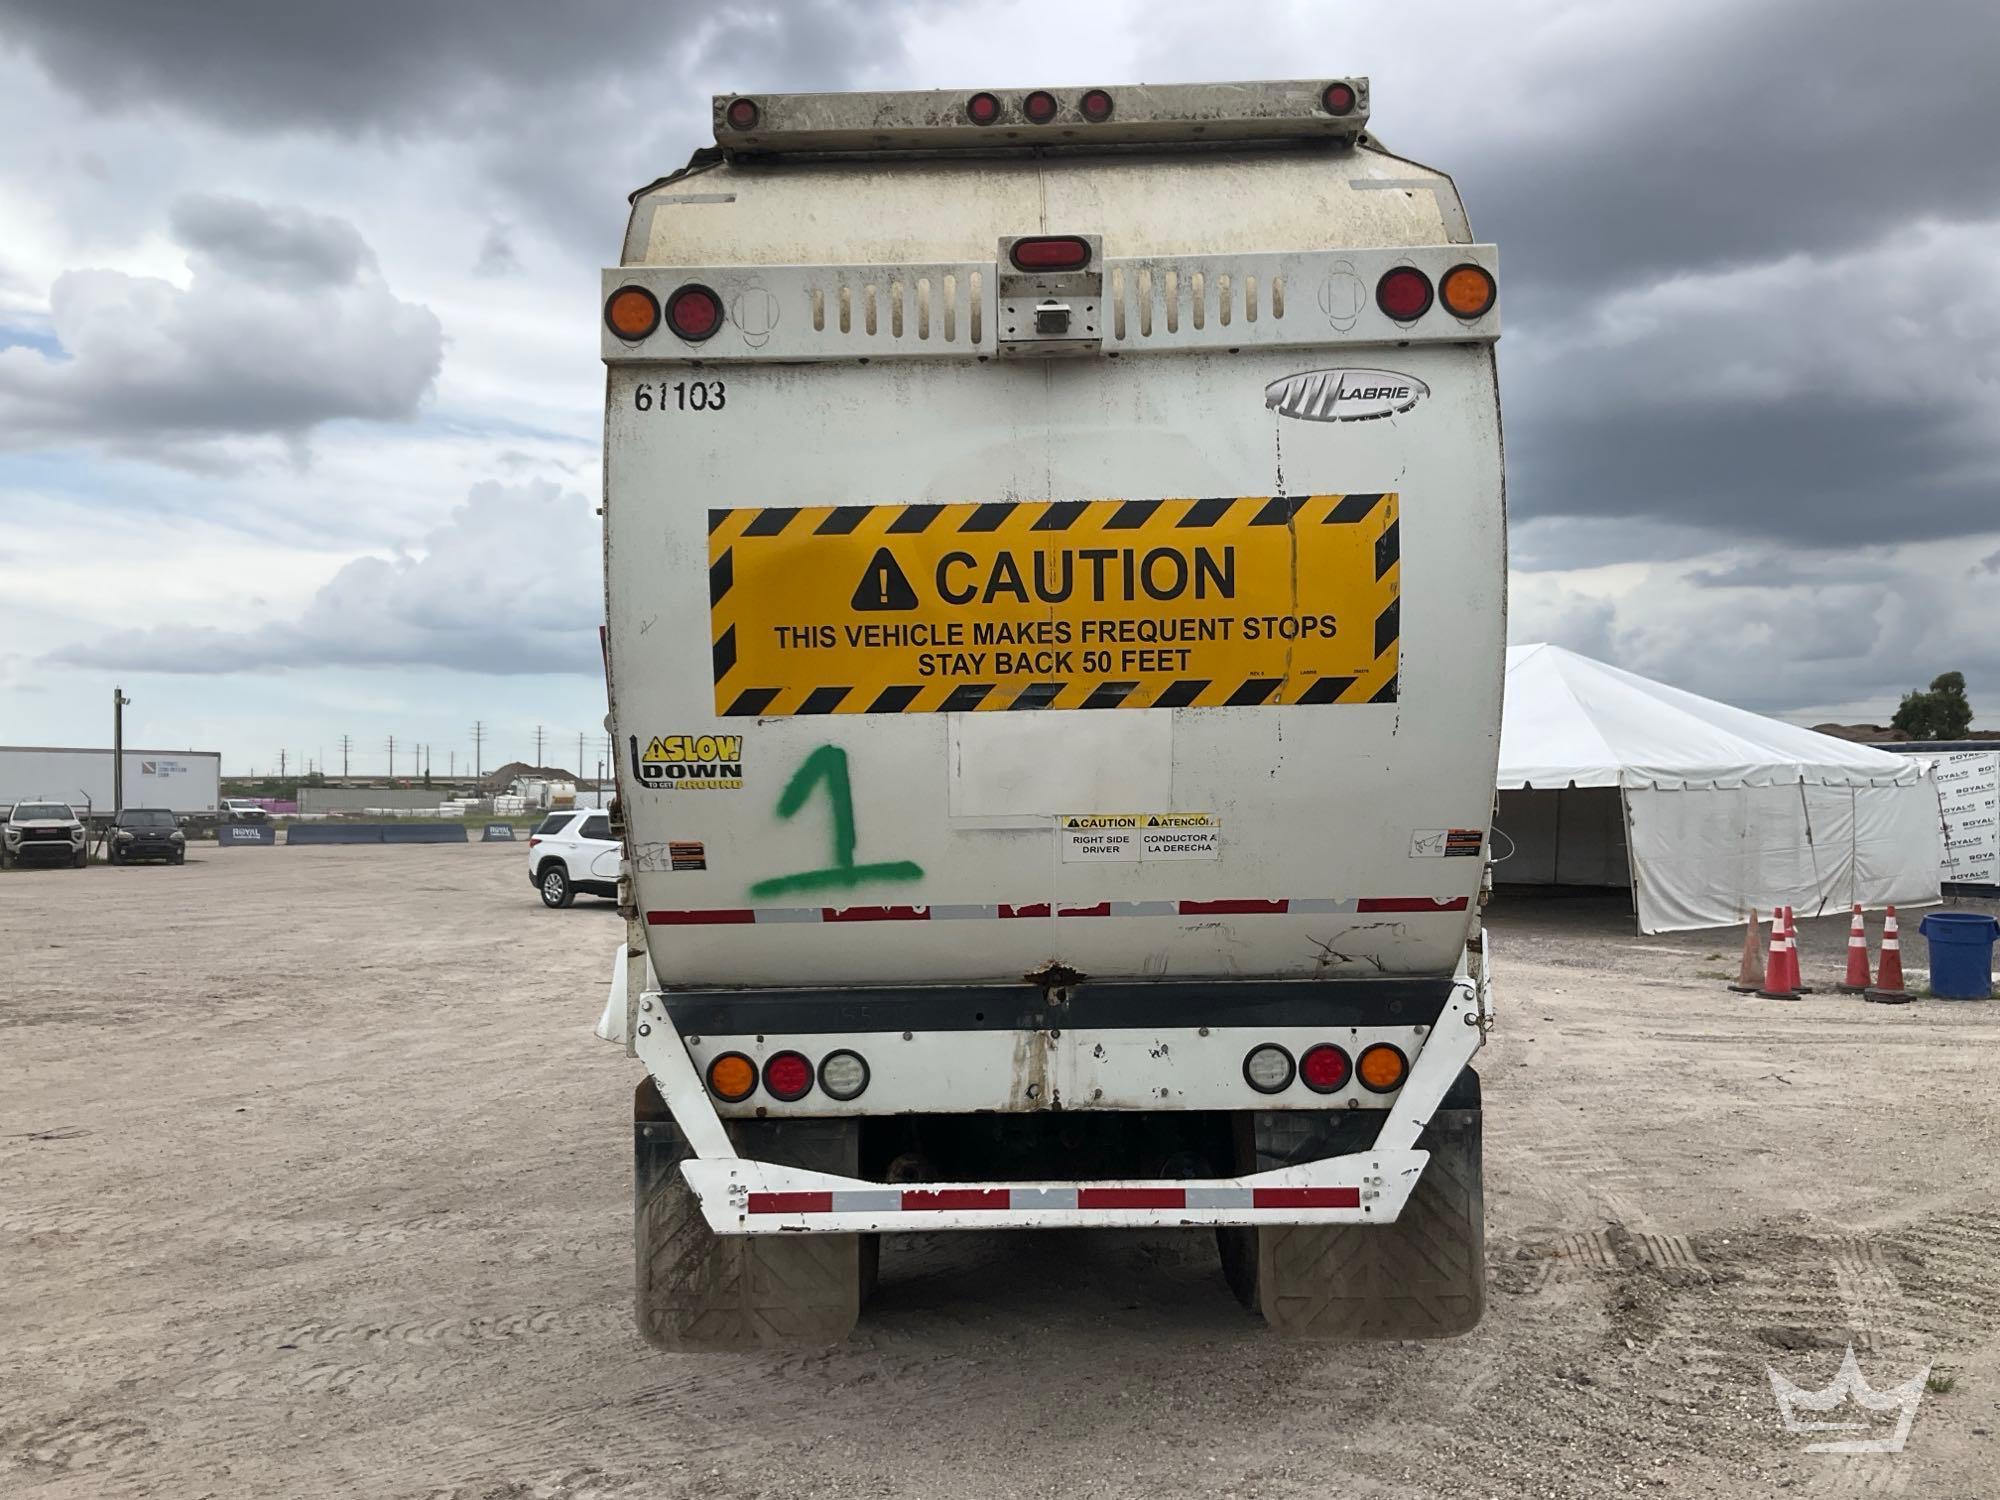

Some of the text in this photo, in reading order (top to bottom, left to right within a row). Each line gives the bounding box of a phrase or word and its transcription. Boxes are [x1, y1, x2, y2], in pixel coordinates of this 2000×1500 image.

[635, 381, 726, 411] 61103
[1338, 386, 1410, 400] LABRIE
[935, 547, 1235, 605] CAUTION
[774, 615, 1337, 648] THIS VEHICLE MAKES FREQUENT STOPS
[918, 649, 1191, 676] STAY BACK 50 FEET
[664, 735, 742, 762] SLOW
[642, 764, 742, 778] DOWN
[675, 780, 743, 789] AROUND
[1956, 785, 1985, 793] ROYAL
[750, 744, 925, 898] 1
[1080, 818, 1136, 828] CAUTION
[233, 828, 260, 836] ROYAL
[1073, 835, 1129, 844] RIGHT SIDE
[1143, 834, 1208, 843] CONDUCTOR
[1082, 845, 1120, 853] DRIVER
[1163, 844, 1212, 852] DERECHA
[1969, 852, 1995, 860] ROYA
[1950, 872, 1981, 880] ROYAL
